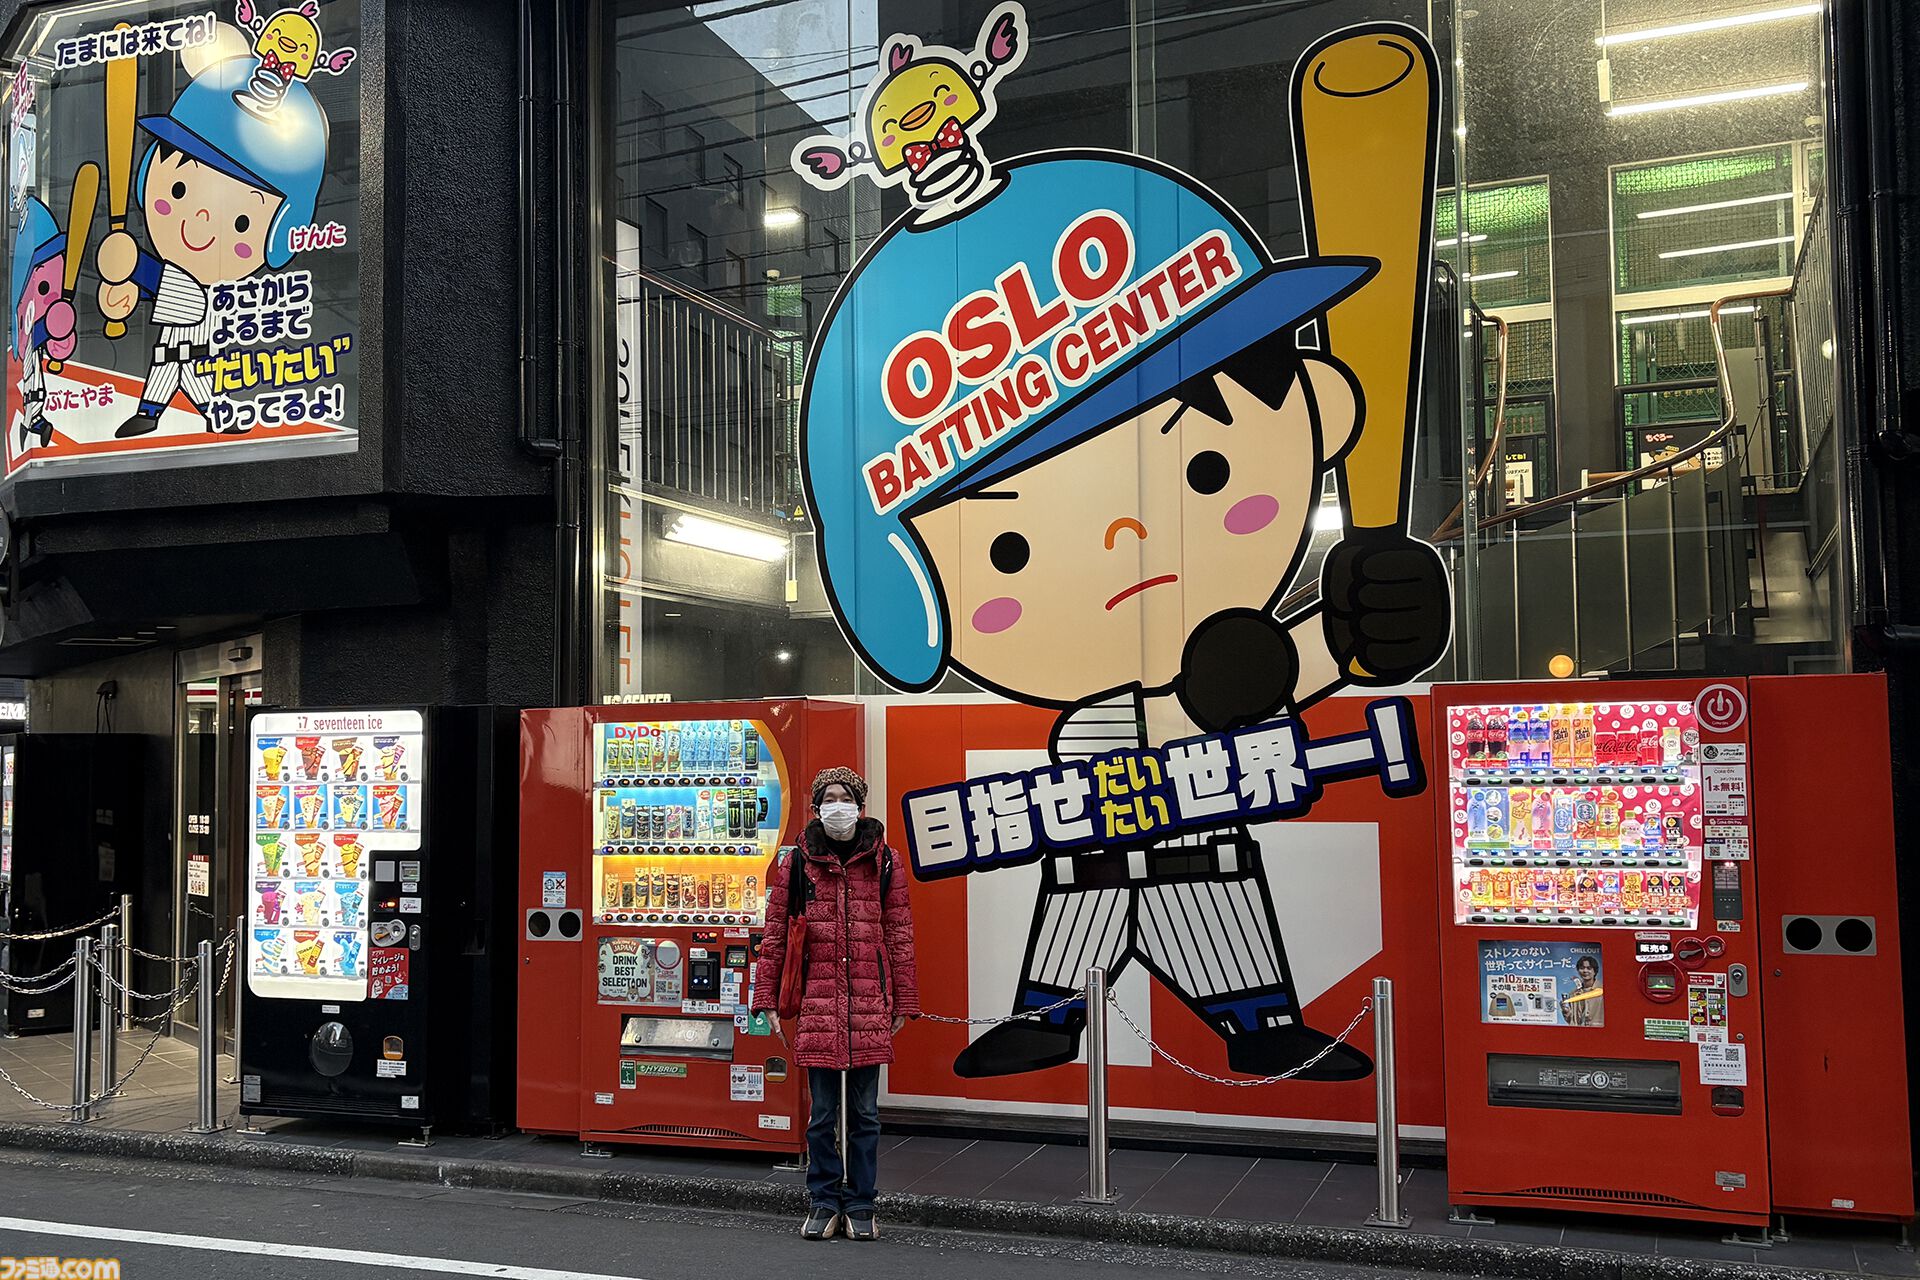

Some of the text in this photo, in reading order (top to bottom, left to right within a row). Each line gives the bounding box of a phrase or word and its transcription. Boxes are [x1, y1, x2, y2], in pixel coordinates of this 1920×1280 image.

[56, 14, 217, 68] たまには来てね!
[289, 222, 346, 252] けんた
[212, 274, 311, 311] あさから
[212, 307, 311, 342] よるまで
[888, 215, 1130, 419] OSLO
[868, 235, 1236, 509] BATTING CENTER
[45, 385, 114, 412] ぶたやま
[210, 390, 343, 431] やってるよ!
[314, 716, 365, 731] seventeen
[368, 714, 383, 730] ice
[614, 725, 661, 741] DyDo
[1705, 776, 1745, 792] 1本無料!
[612, 955, 638, 966] DRINK
[1484, 946, 1551, 959] ストレスのない
[614, 966, 636, 976] BEST
[1485, 957, 1576, 972] 世界って、サイコーだ。
[1491, 984, 1540, 992] その場で当たる!
[645, 1065, 679, 1073] HYBRID
